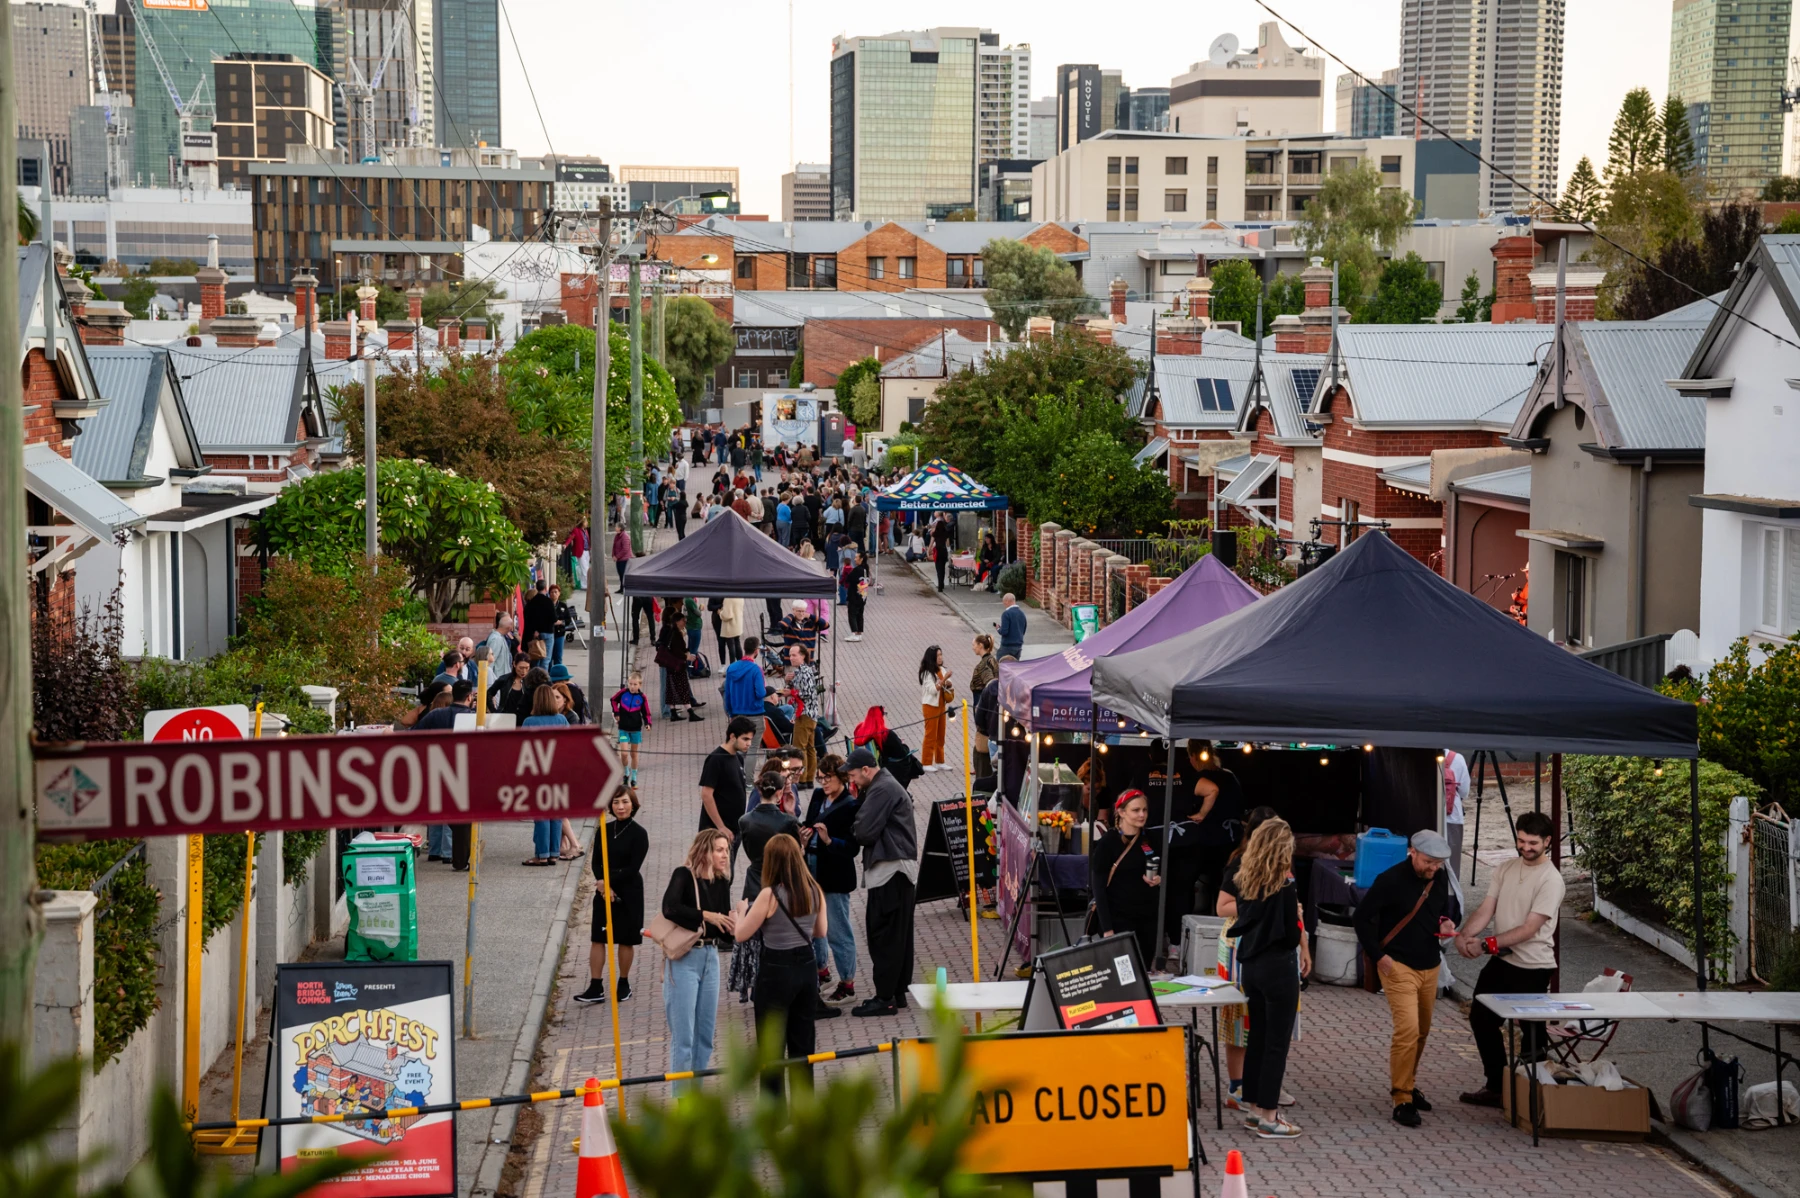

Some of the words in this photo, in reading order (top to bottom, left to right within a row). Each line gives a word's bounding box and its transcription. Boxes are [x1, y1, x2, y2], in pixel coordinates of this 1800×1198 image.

[900, 500, 930, 509] Better
[932, 500, 986, 508] Connected
[1052, 707, 1118, 718] pofferjes
[182, 727, 213, 743] NO
[124, 743, 470, 826] ROBINSON
[515, 739, 557, 777] AV
[498, 785, 530, 813] 92
[535, 783, 569, 810] ON
[940, 802, 958, 812] Little
[335, 981, 353, 990] town
[297, 989, 326, 997] BRIDGE
[333, 989, 352, 998] team
[1069, 1006, 1078, 1014] PLAY
[1078, 1003, 1094, 1012] SCHEDULE
[292, 1008, 439, 1066] PORCHFEST
[1034, 1082, 1166, 1122] CLOSED
